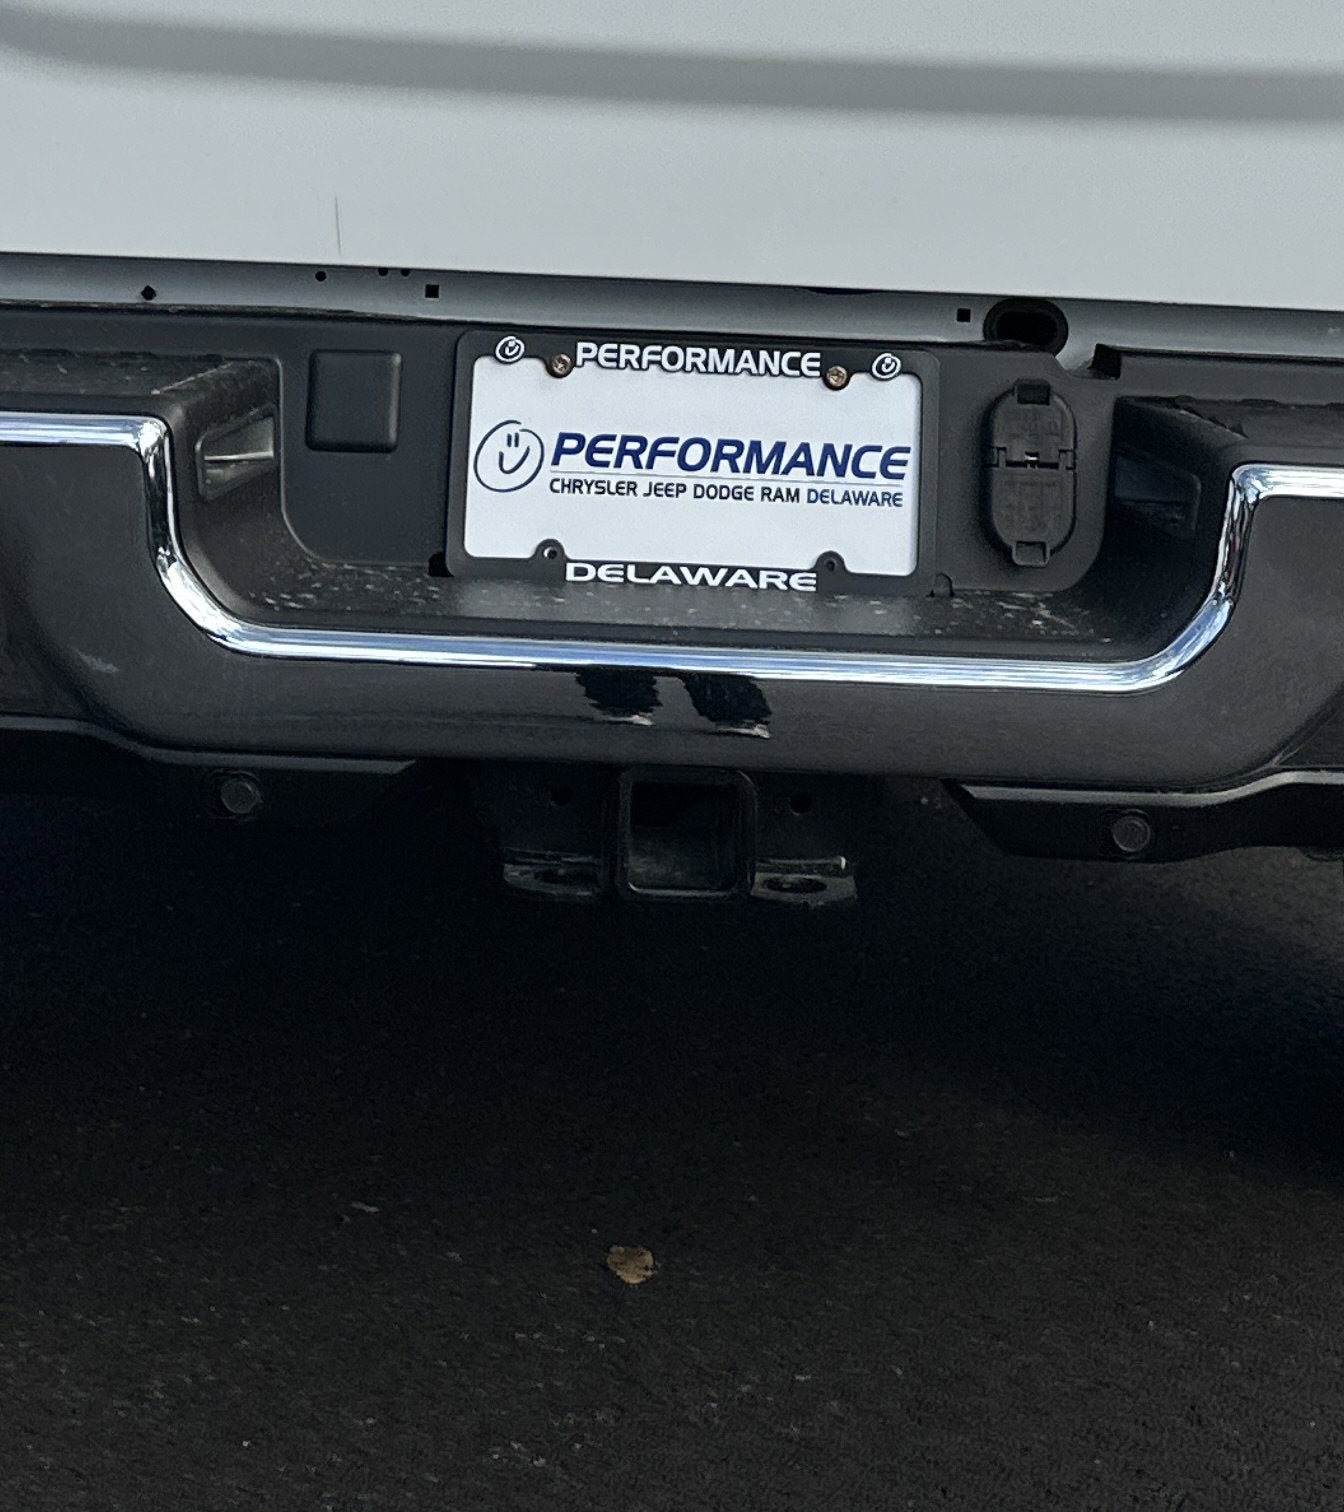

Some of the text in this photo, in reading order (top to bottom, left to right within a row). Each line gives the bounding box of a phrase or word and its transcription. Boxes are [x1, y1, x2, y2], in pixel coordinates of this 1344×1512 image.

[575, 341, 821, 378] PERFORMANCE
[551, 432, 911, 480] PERFORMANCE
[549, 478, 903, 507] CHRYSLER JEEP DODGE RAM DELAWARE
[565, 562, 817, 592] DELAWARE
